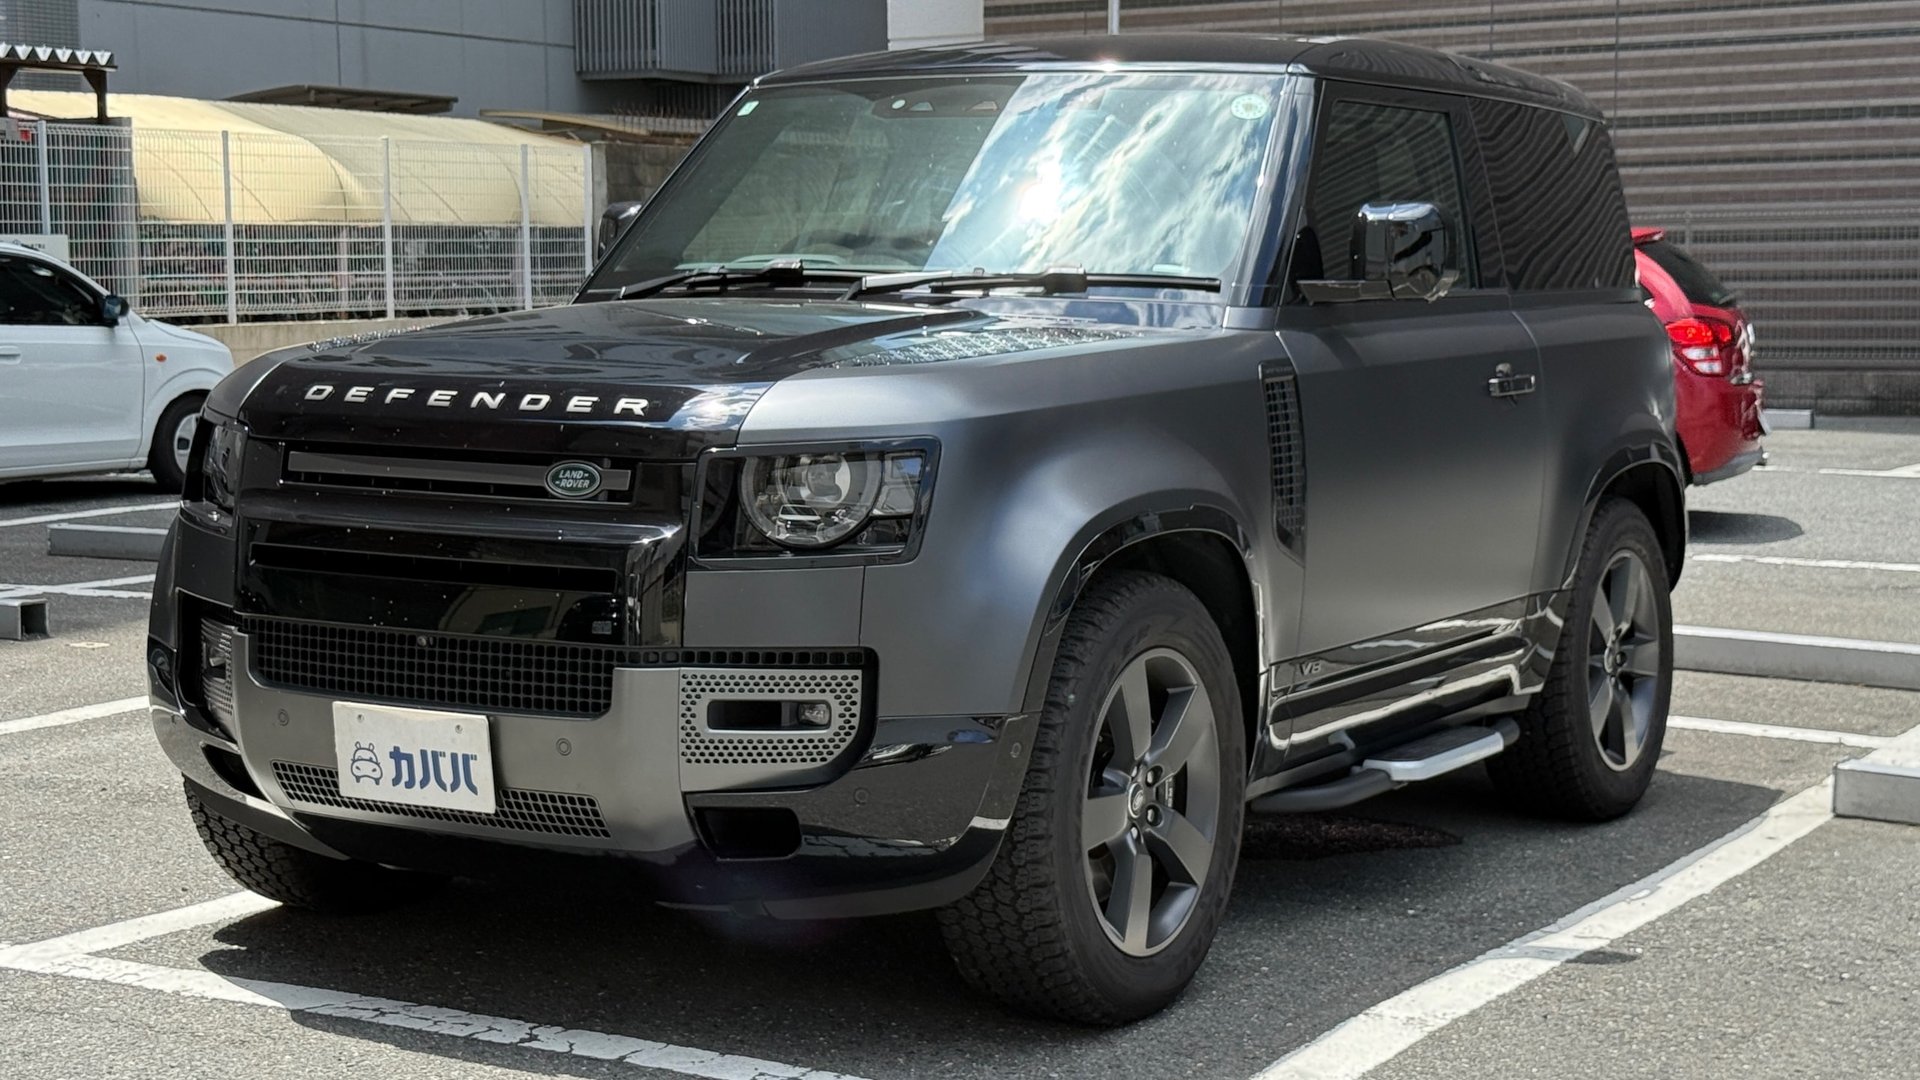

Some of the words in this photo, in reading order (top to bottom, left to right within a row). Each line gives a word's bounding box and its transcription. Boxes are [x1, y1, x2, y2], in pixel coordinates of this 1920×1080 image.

[304, 385, 649, 416] DEFENDER
[1300, 661, 1321, 676] V8
[389, 745, 478, 796] カババ
